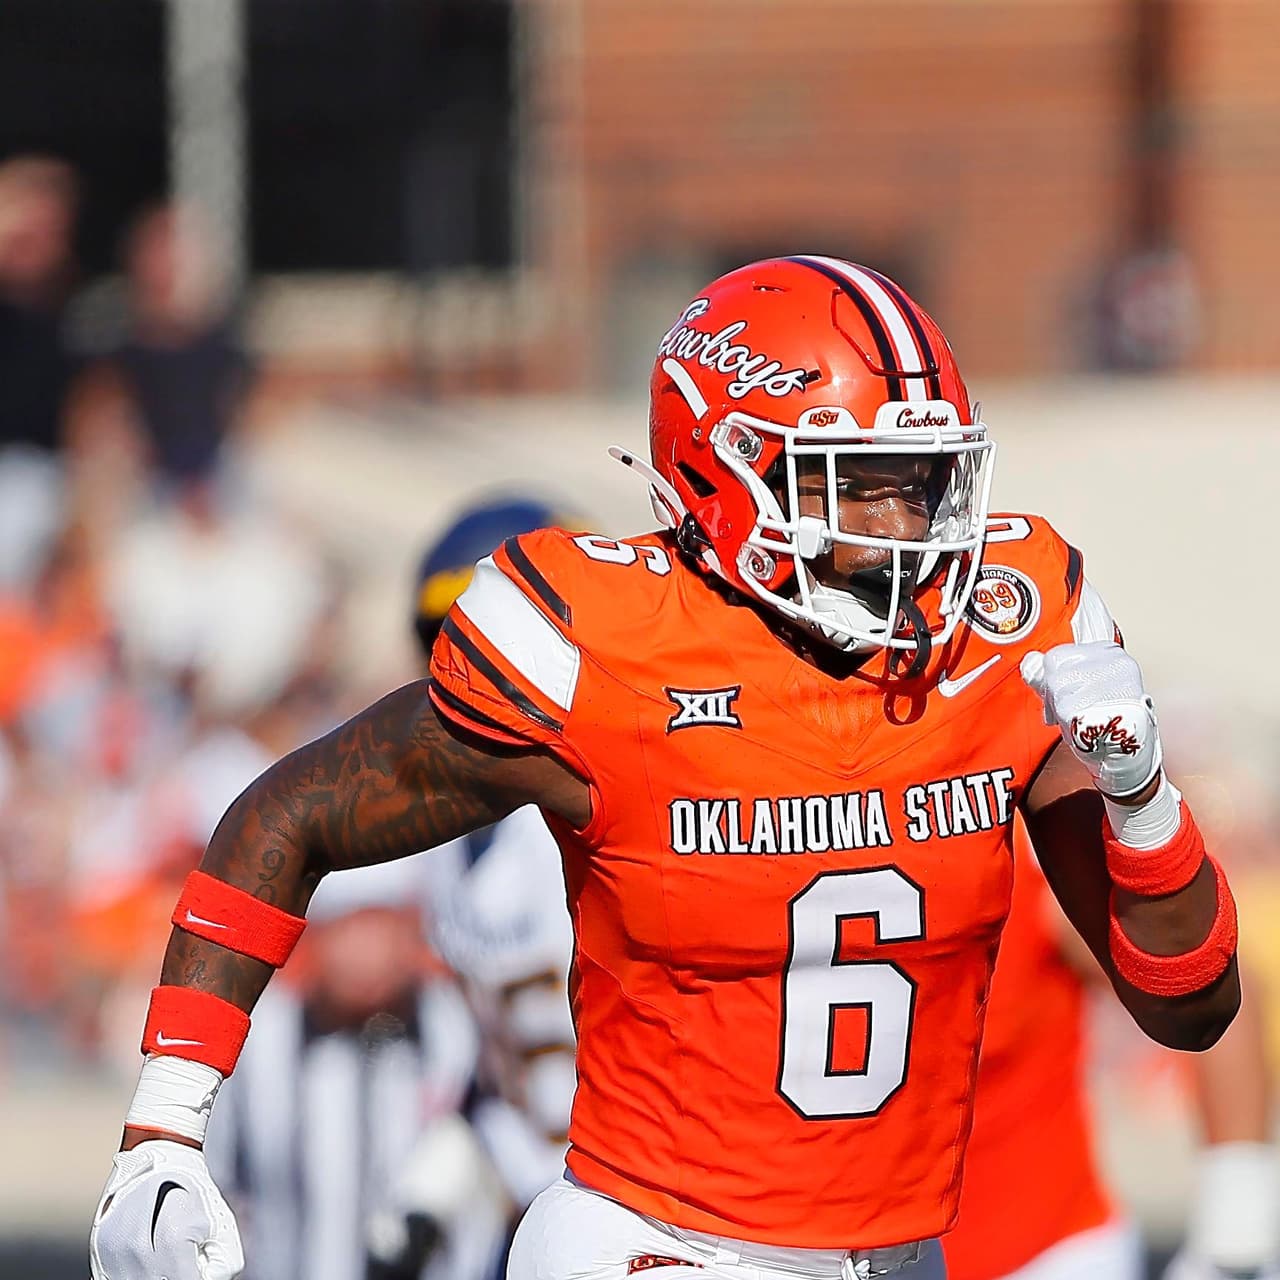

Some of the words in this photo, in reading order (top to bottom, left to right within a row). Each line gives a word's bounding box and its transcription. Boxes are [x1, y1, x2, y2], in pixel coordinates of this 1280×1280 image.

[659, 297, 806, 400] Cowboys
[896, 408, 950, 428] Cowboys
[974, 582, 1017, 613] 99
[665, 685, 743, 734] XII
[669, 789, 893, 855] OKLAHOMA
[906, 766, 1015, 842] STATE
[775, 863, 926, 1121] 6
